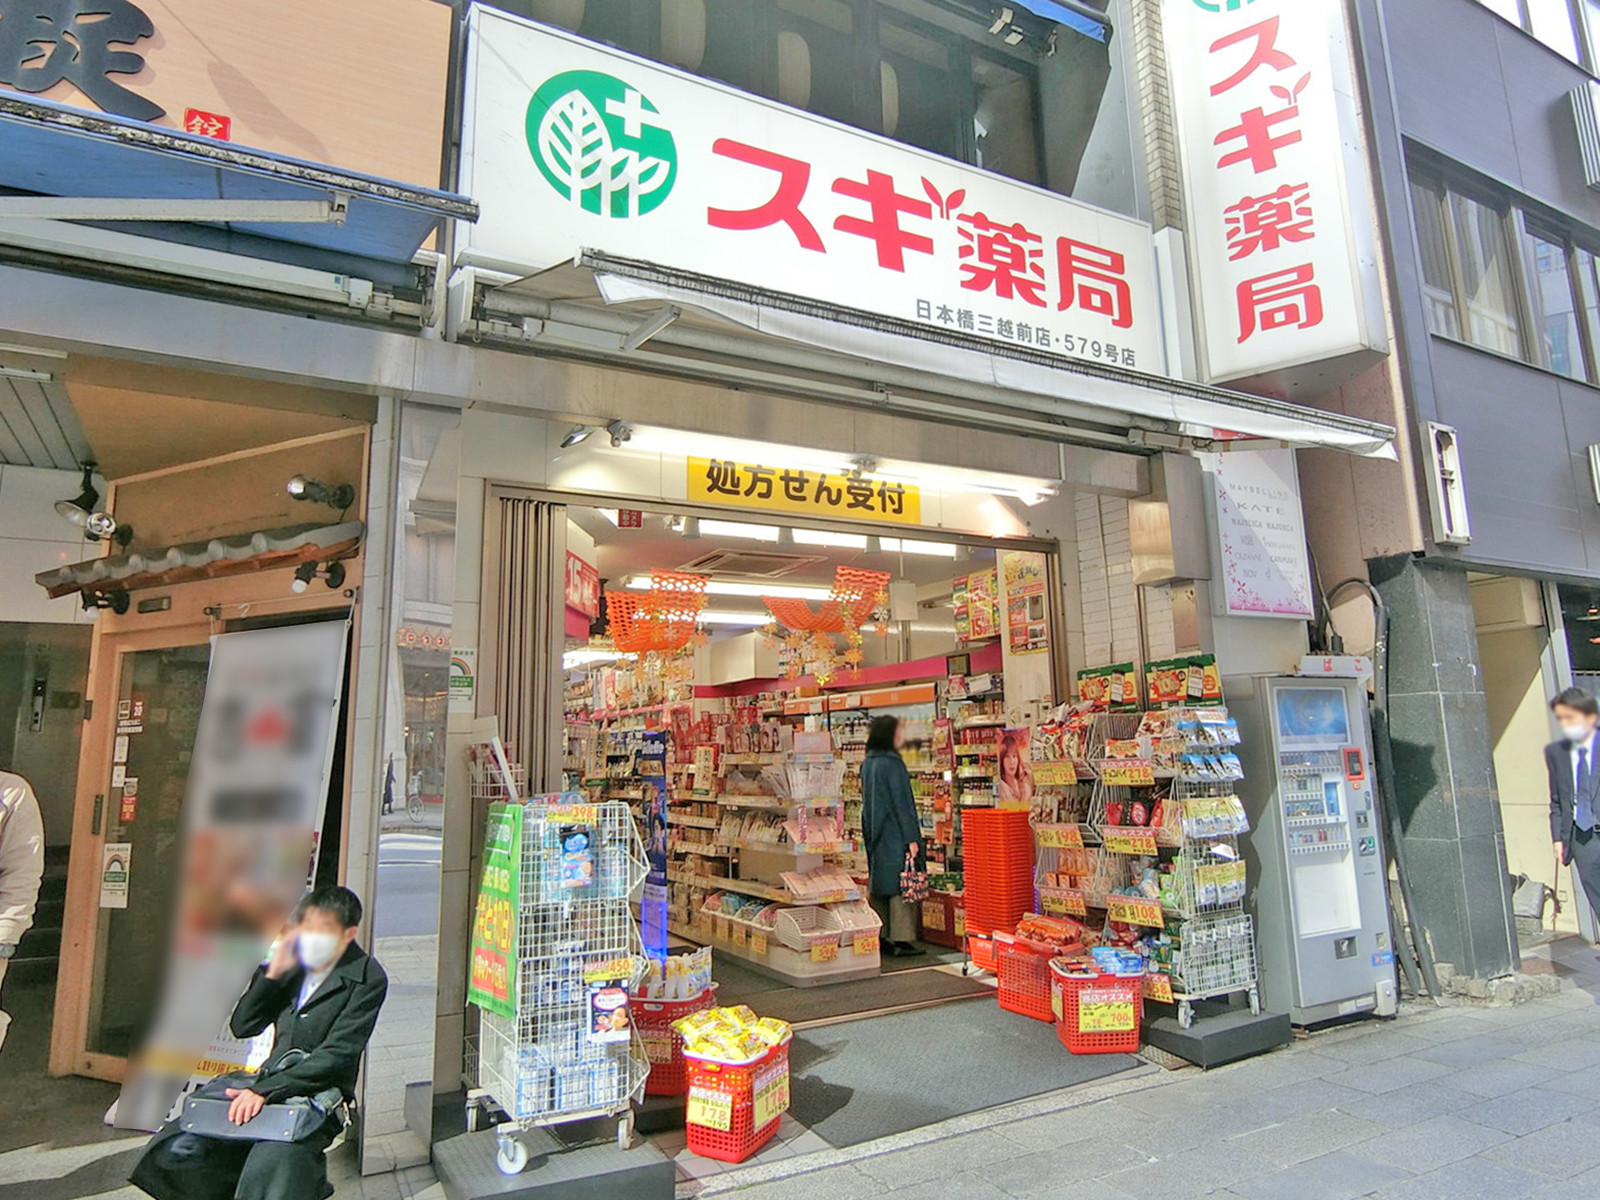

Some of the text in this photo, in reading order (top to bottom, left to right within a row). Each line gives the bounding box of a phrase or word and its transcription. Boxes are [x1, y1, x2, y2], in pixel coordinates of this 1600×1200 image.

[1209, 15, 1324, 344] スギ薬局
[707, 137, 1133, 329] スギ薬局
[706, 458, 906, 515] 処方せん受付
[1236, 502, 1286, 515] KATE
[1127, 767, 1149, 779] 278
[573, 806, 593, 818] 398
[1131, 837, 1151, 848] 278
[1135, 904, 1157, 919] 108
[609, 959, 630, 972] 450
[1111, 1012, 1128, 1022] 700
[700, 1104, 728, 1118] 178
